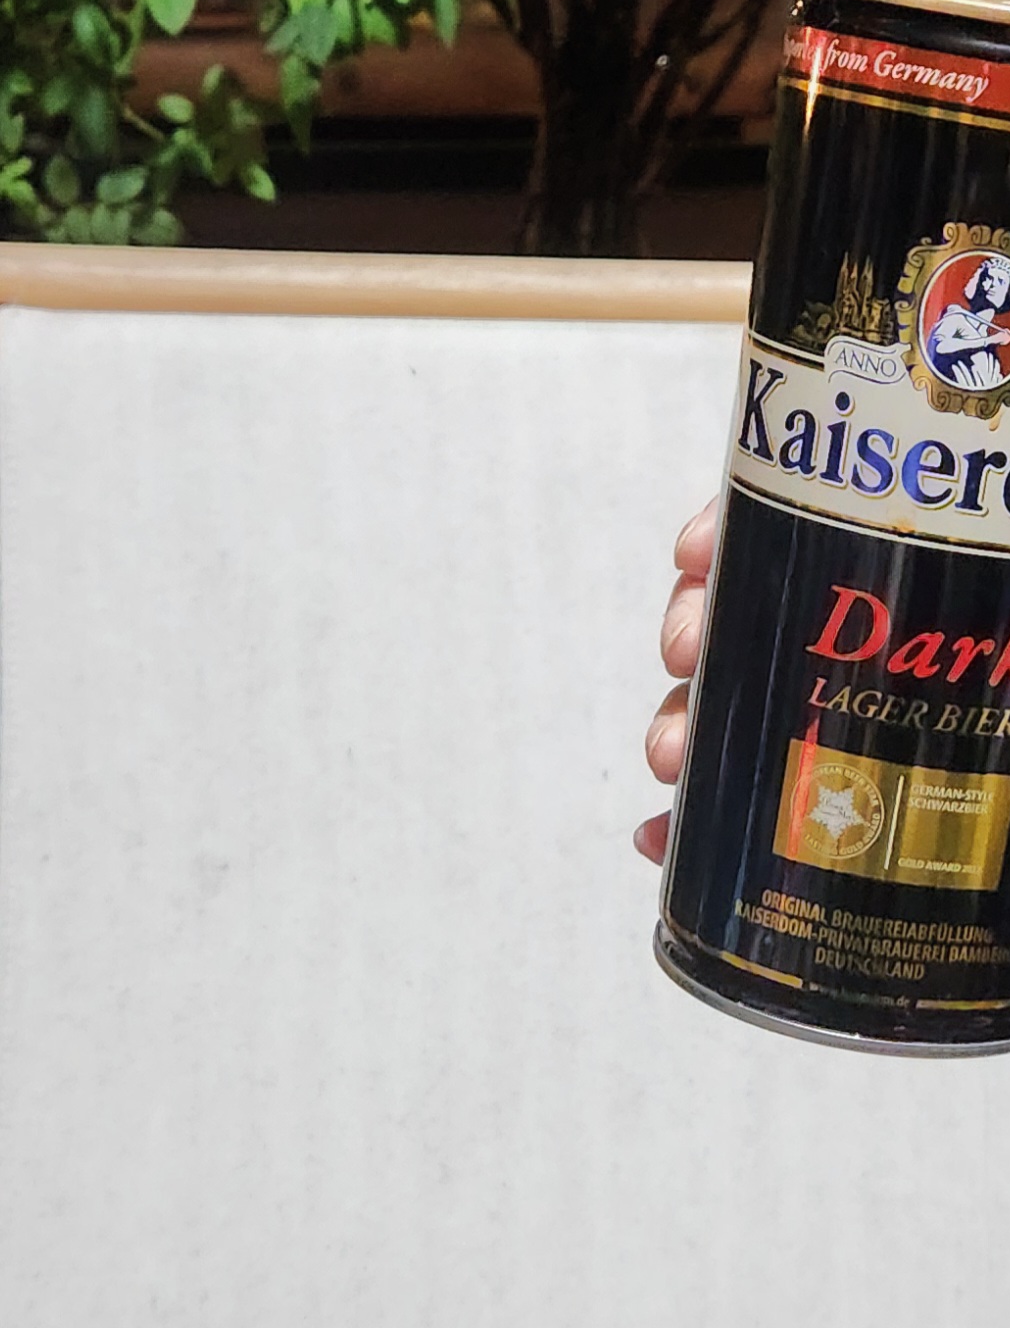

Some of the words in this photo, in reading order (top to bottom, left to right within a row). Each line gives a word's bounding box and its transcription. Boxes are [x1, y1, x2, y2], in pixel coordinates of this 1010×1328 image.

[821, 38, 868, 74] from
[873, 50, 990, 102] Germany
[834, 349, 898, 376] ANNO
[808, 677, 929, 729] LAGER
[908, 797, 988, 814] SCHWARZBIER
[911, 784, 993, 802] GERMAN-STYLE
[898, 858, 924, 869] GOLD
[925, 860, 962, 872] AWARD
[762, 889, 828, 925] ORIGINAL
